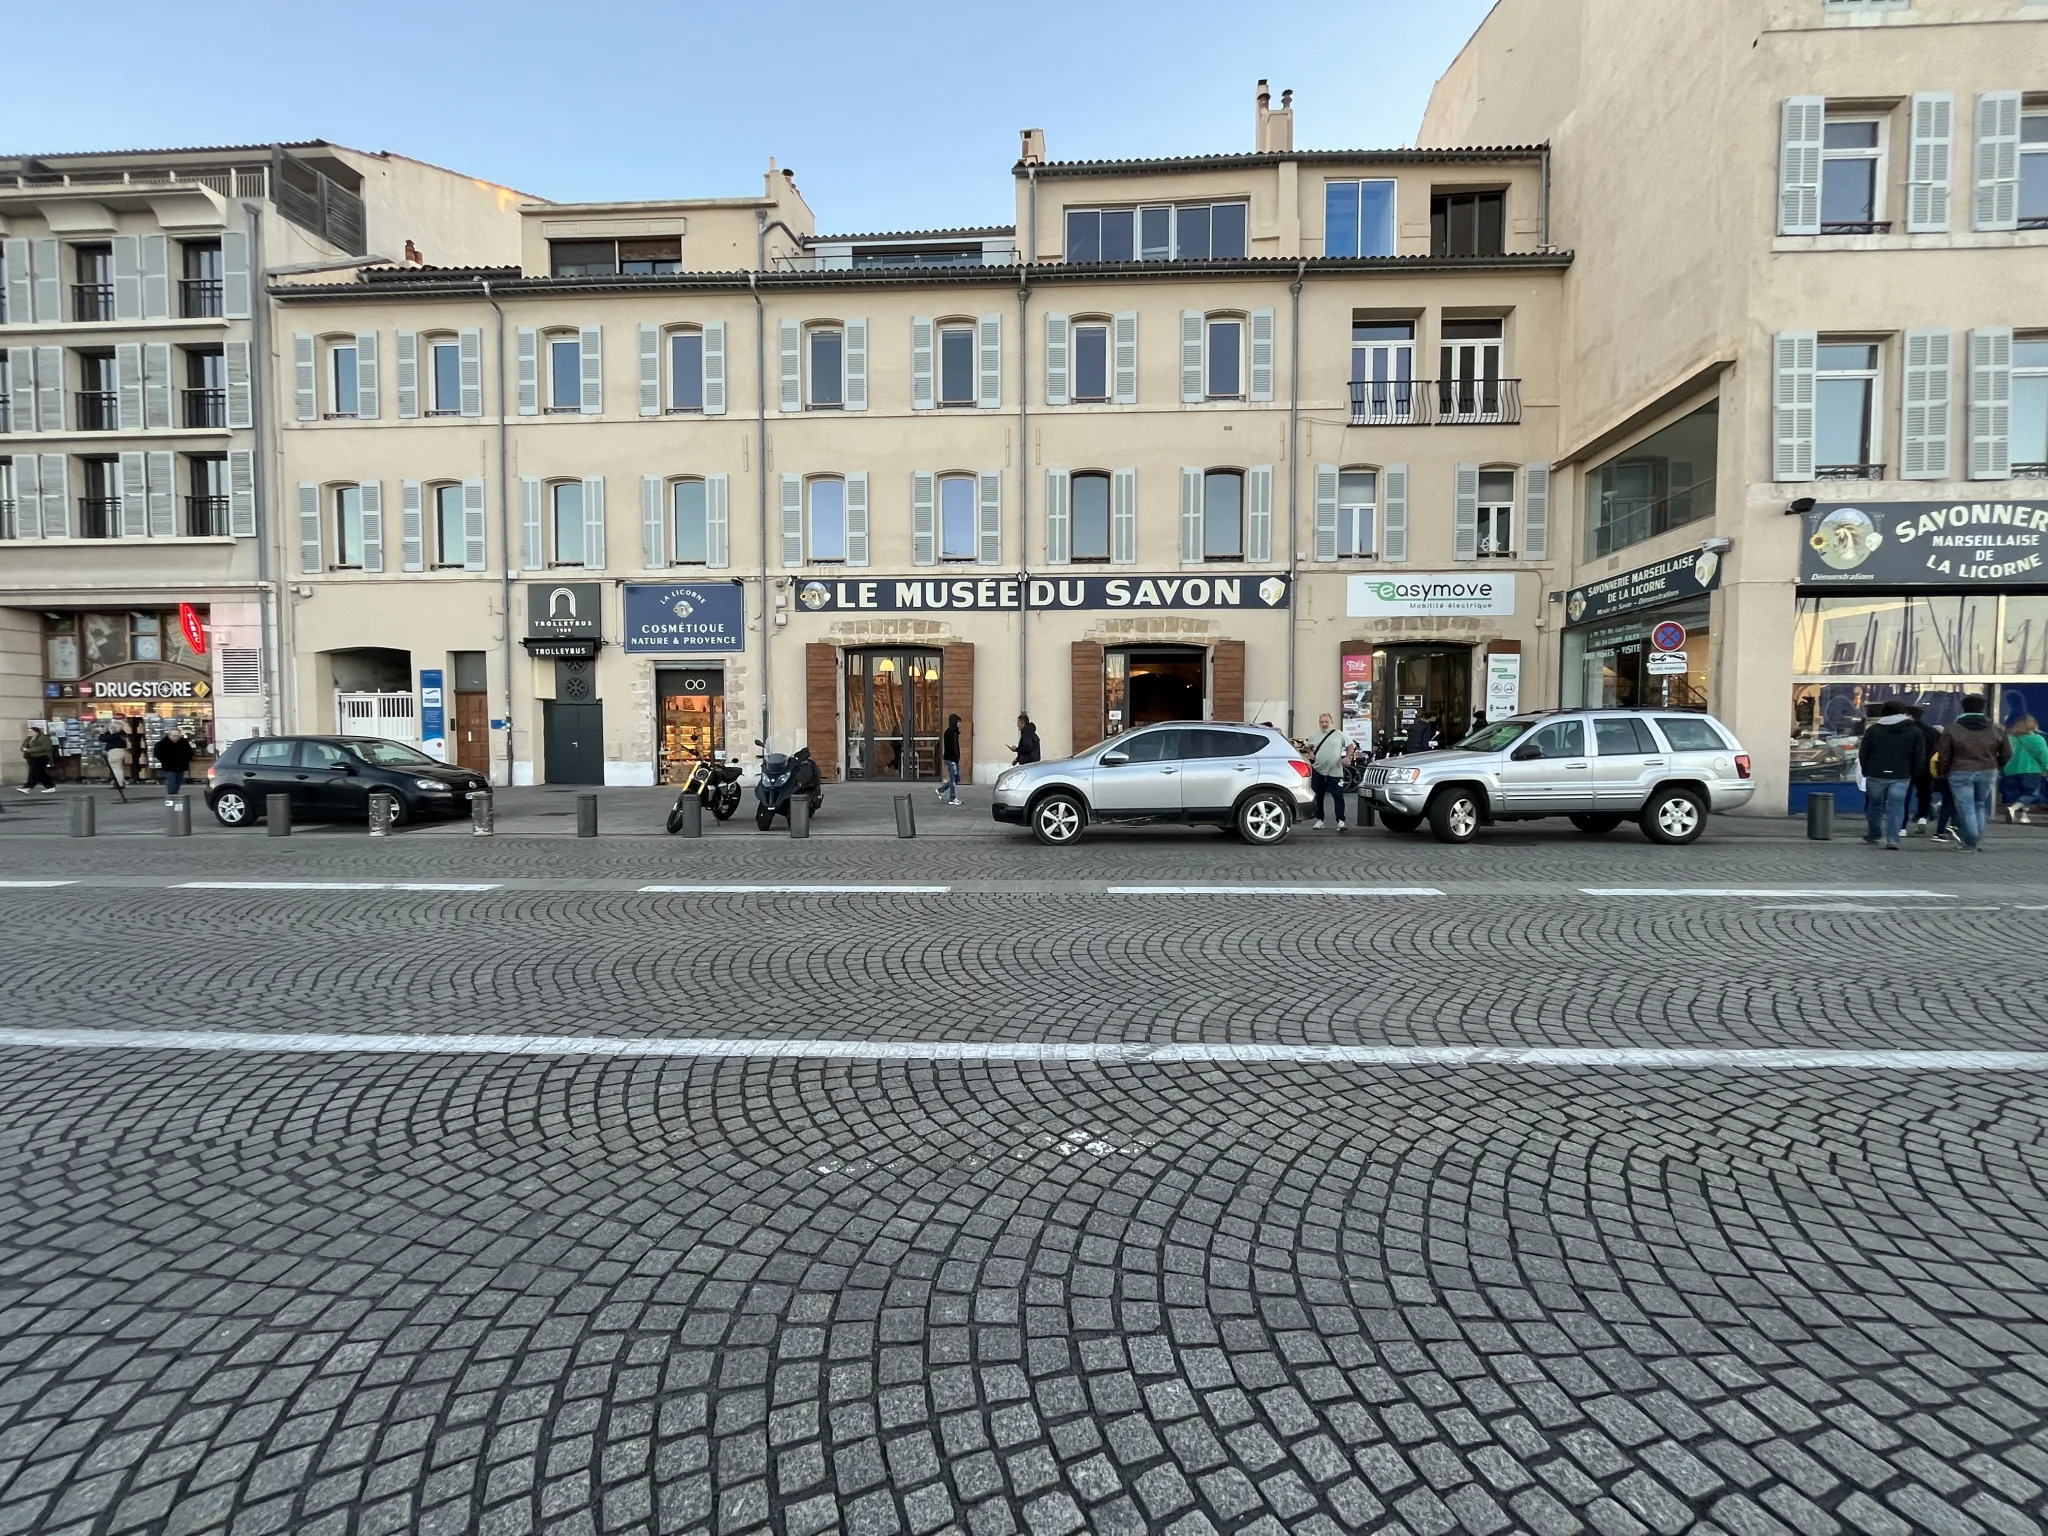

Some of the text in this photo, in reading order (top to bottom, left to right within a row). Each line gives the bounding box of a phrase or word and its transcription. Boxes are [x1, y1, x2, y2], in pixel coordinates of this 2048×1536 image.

[1932, 534, 2040, 547] MARSEILLAISE
[1975, 549, 1995, 561] DE
[1926, 553, 2043, 579] LA LICORNE
[1588, 555, 1695, 597] SAVONNERIE MARSEILLAISE
[659, 589, 707, 605] LA LICORNE
[836, 578, 1241, 608] LE MUSÉE DU SAVON
[1376, 581, 1493, 601] easymove
[1607, 578, 1666, 603] DE LA LICORNE
[186, 612, 200, 643] TABAC
[641, 622, 725, 635] COSMÉTIQUE
[631, 636, 737, 645] NATURE & PROVENCE
[535, 647, 586, 655] TROLLEYBUS
[95, 681, 192, 698] DRUGSTORE
